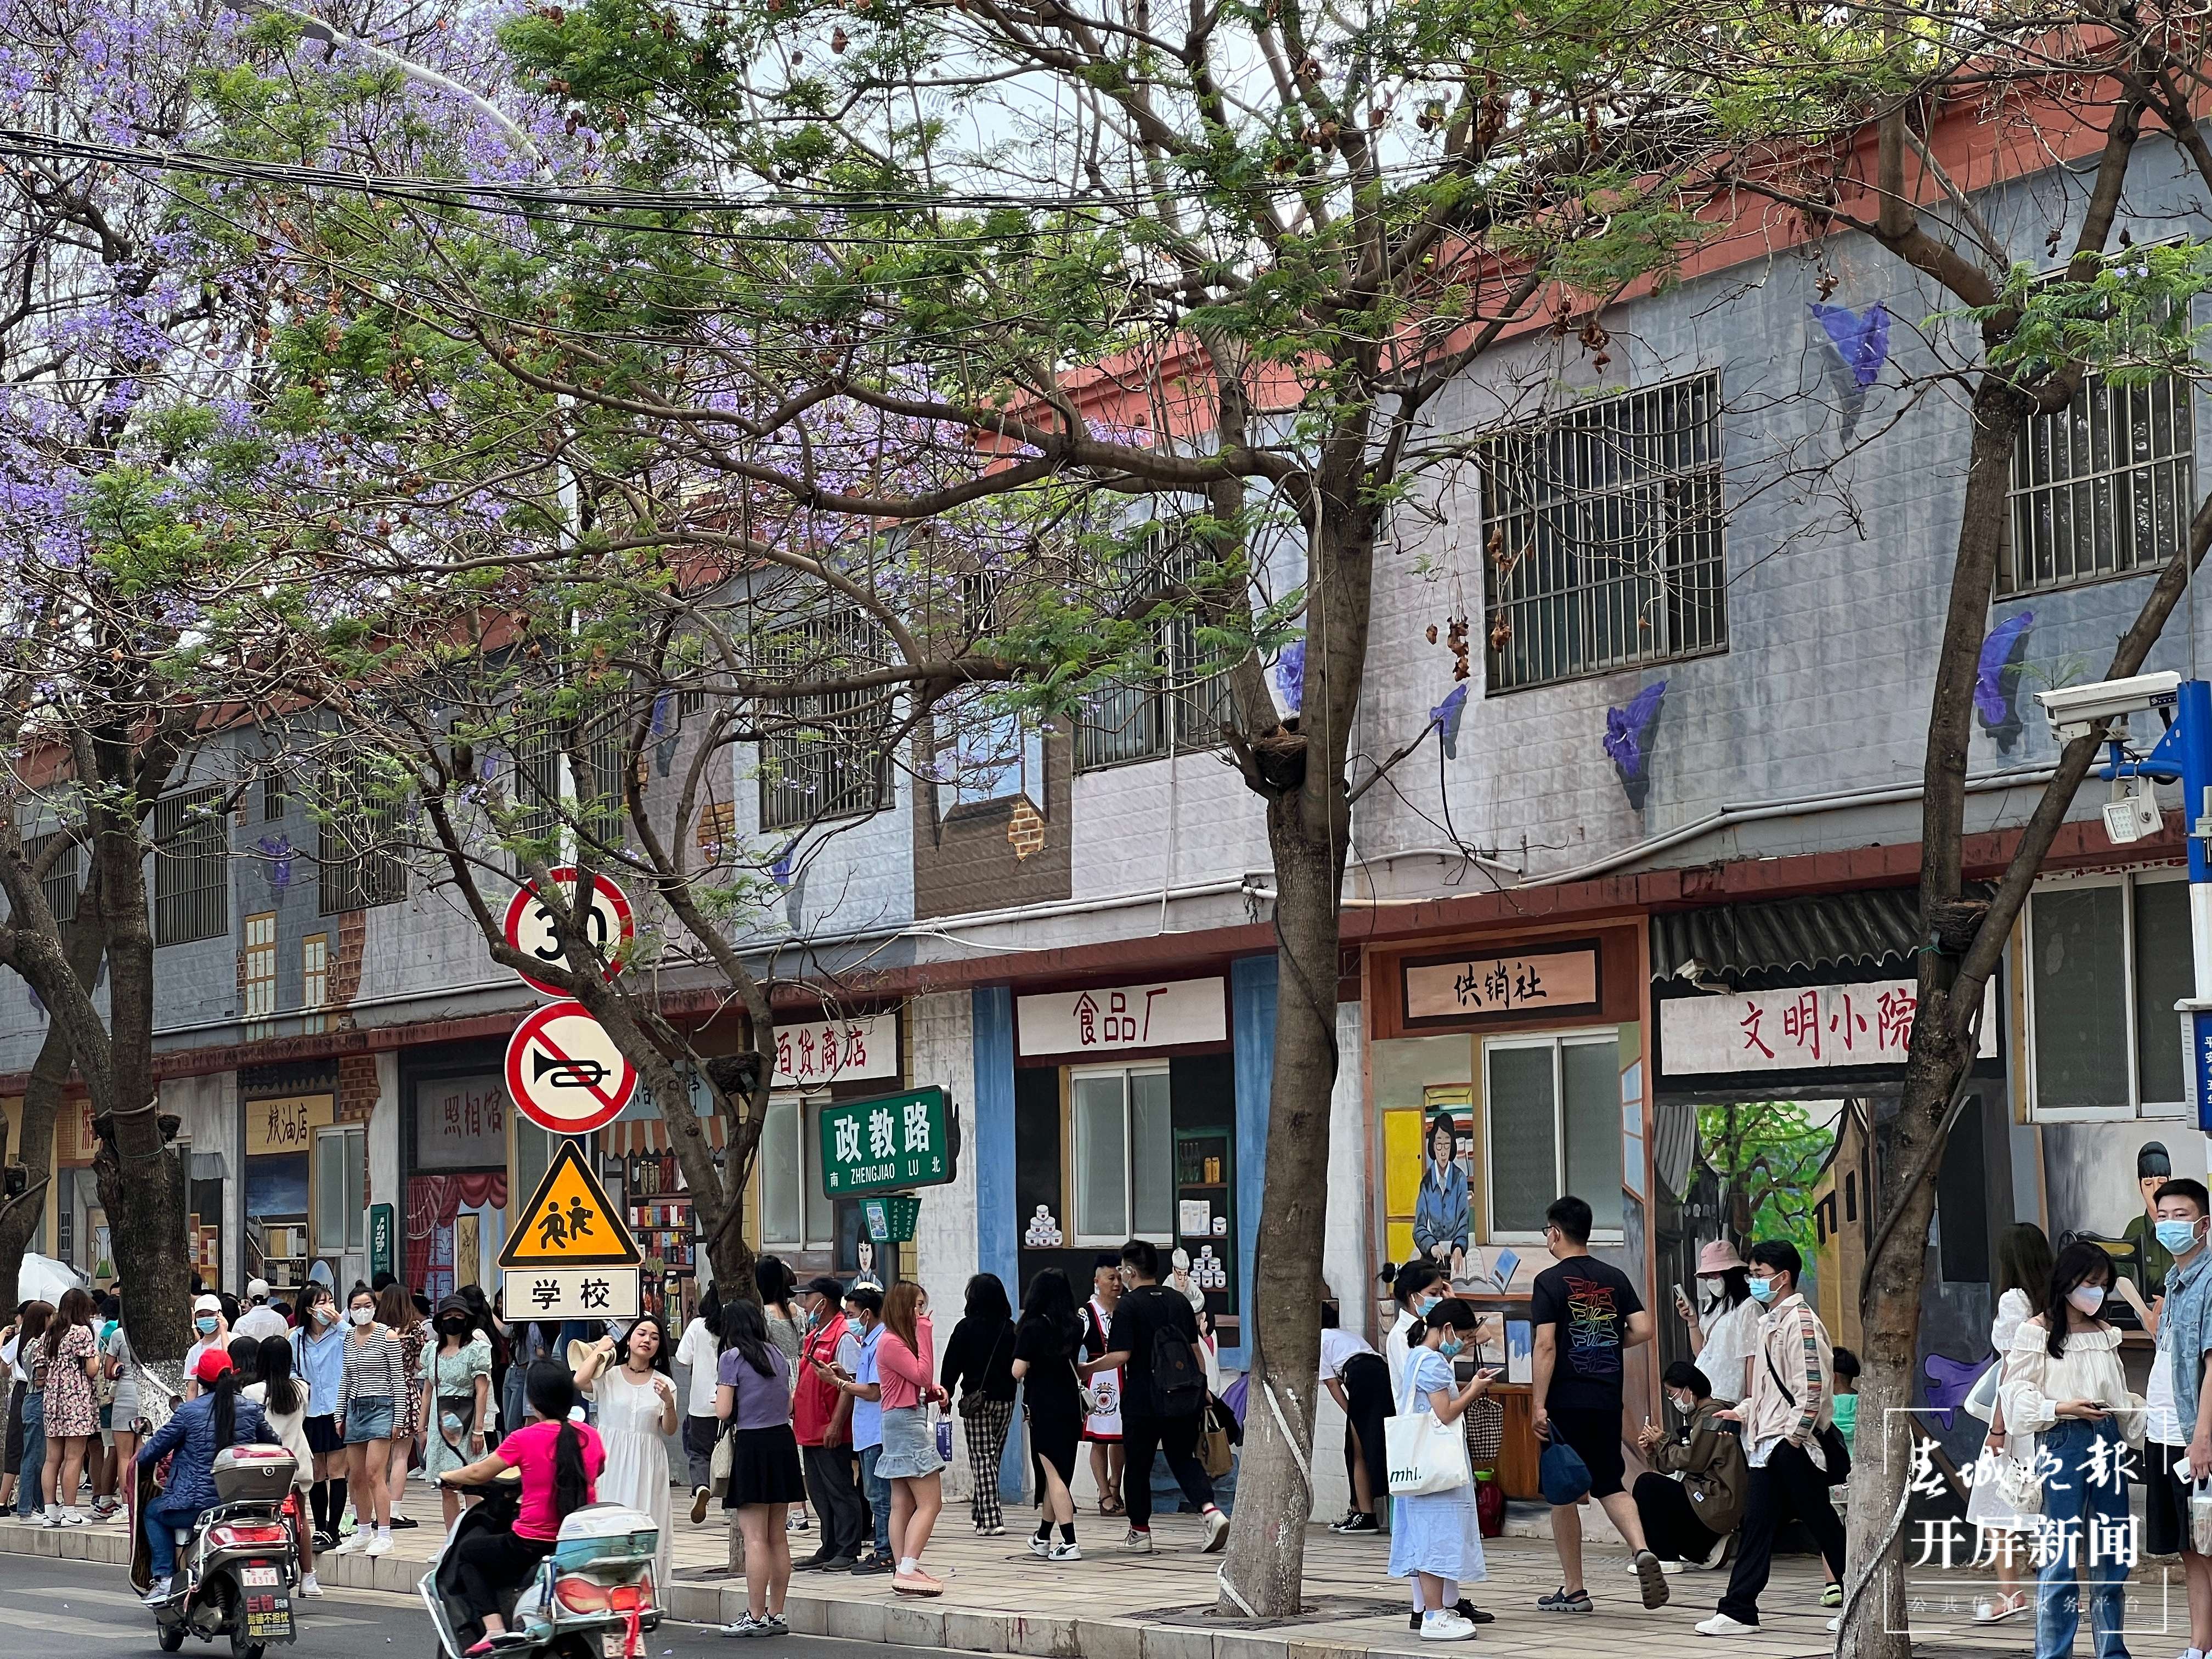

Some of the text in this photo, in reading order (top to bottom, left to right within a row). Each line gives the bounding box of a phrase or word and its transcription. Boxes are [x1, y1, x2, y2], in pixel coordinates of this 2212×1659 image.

[1454, 960, 1547, 1009] 供销社
[1073, 988, 1167, 1045] 食品厂
[1740, 988, 1917, 1060] 文明小院
[777, 1025, 866, 1076] 百货商店
[267, 1102, 307, 1145] 粮油店
[444, 1085, 503, 1138] 照相馆
[834, 1102, 930, 1164] 政教路
[830, 1171, 838, 1187] 南
[851, 1159, 918, 1185] ZHENGJIAO LU
[932, 1156, 941, 1173] 北
[532, 1278, 610, 1310] 学校
[1390, 1466, 1421, 1483] mhl.
